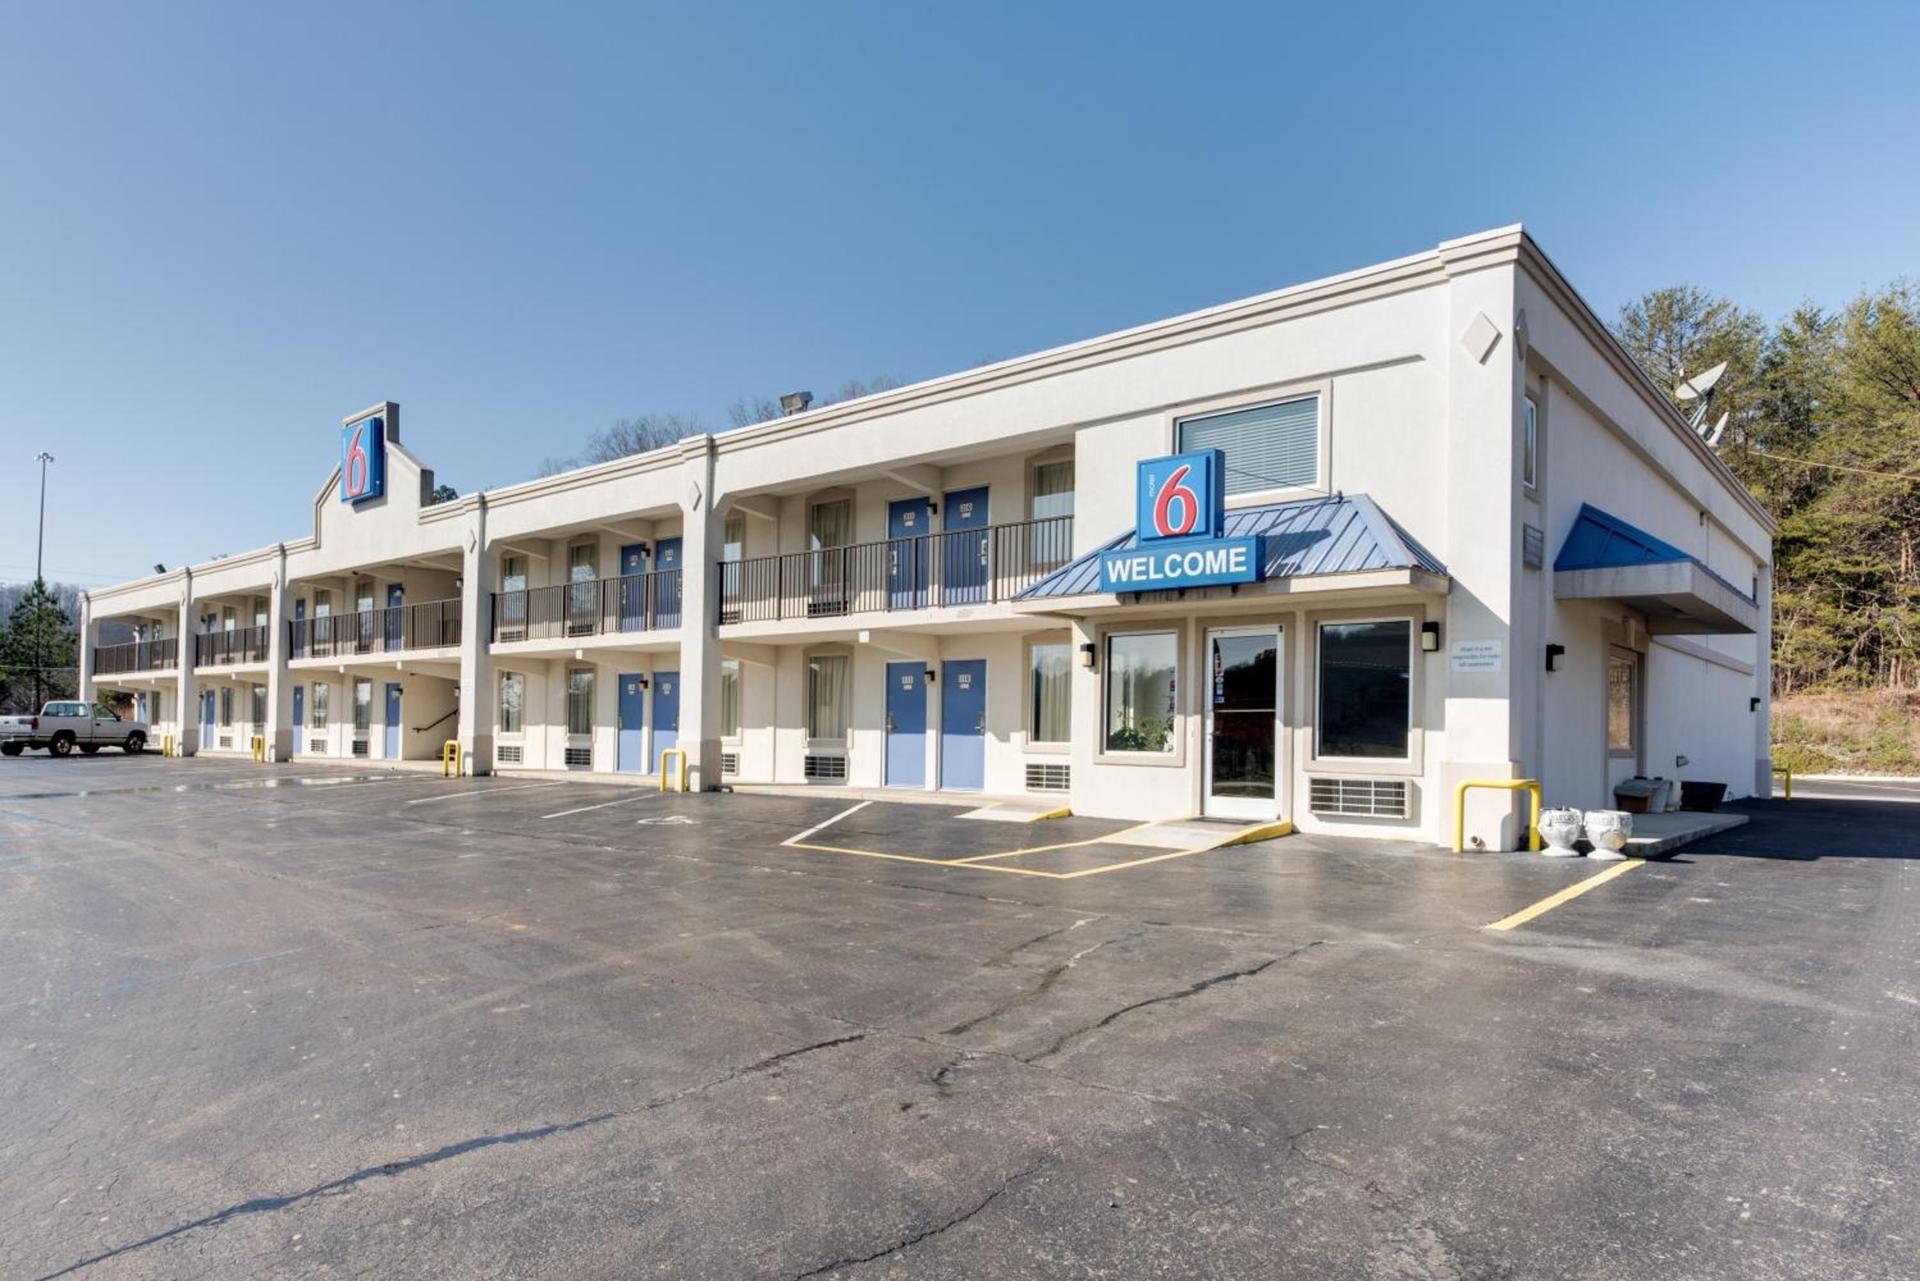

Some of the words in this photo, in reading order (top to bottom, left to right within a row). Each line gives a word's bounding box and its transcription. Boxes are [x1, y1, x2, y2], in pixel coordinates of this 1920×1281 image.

[345, 424, 366, 497] 6
[1153, 464, 1199, 537] 6
[1107, 547, 1247, 583] WELCOME
